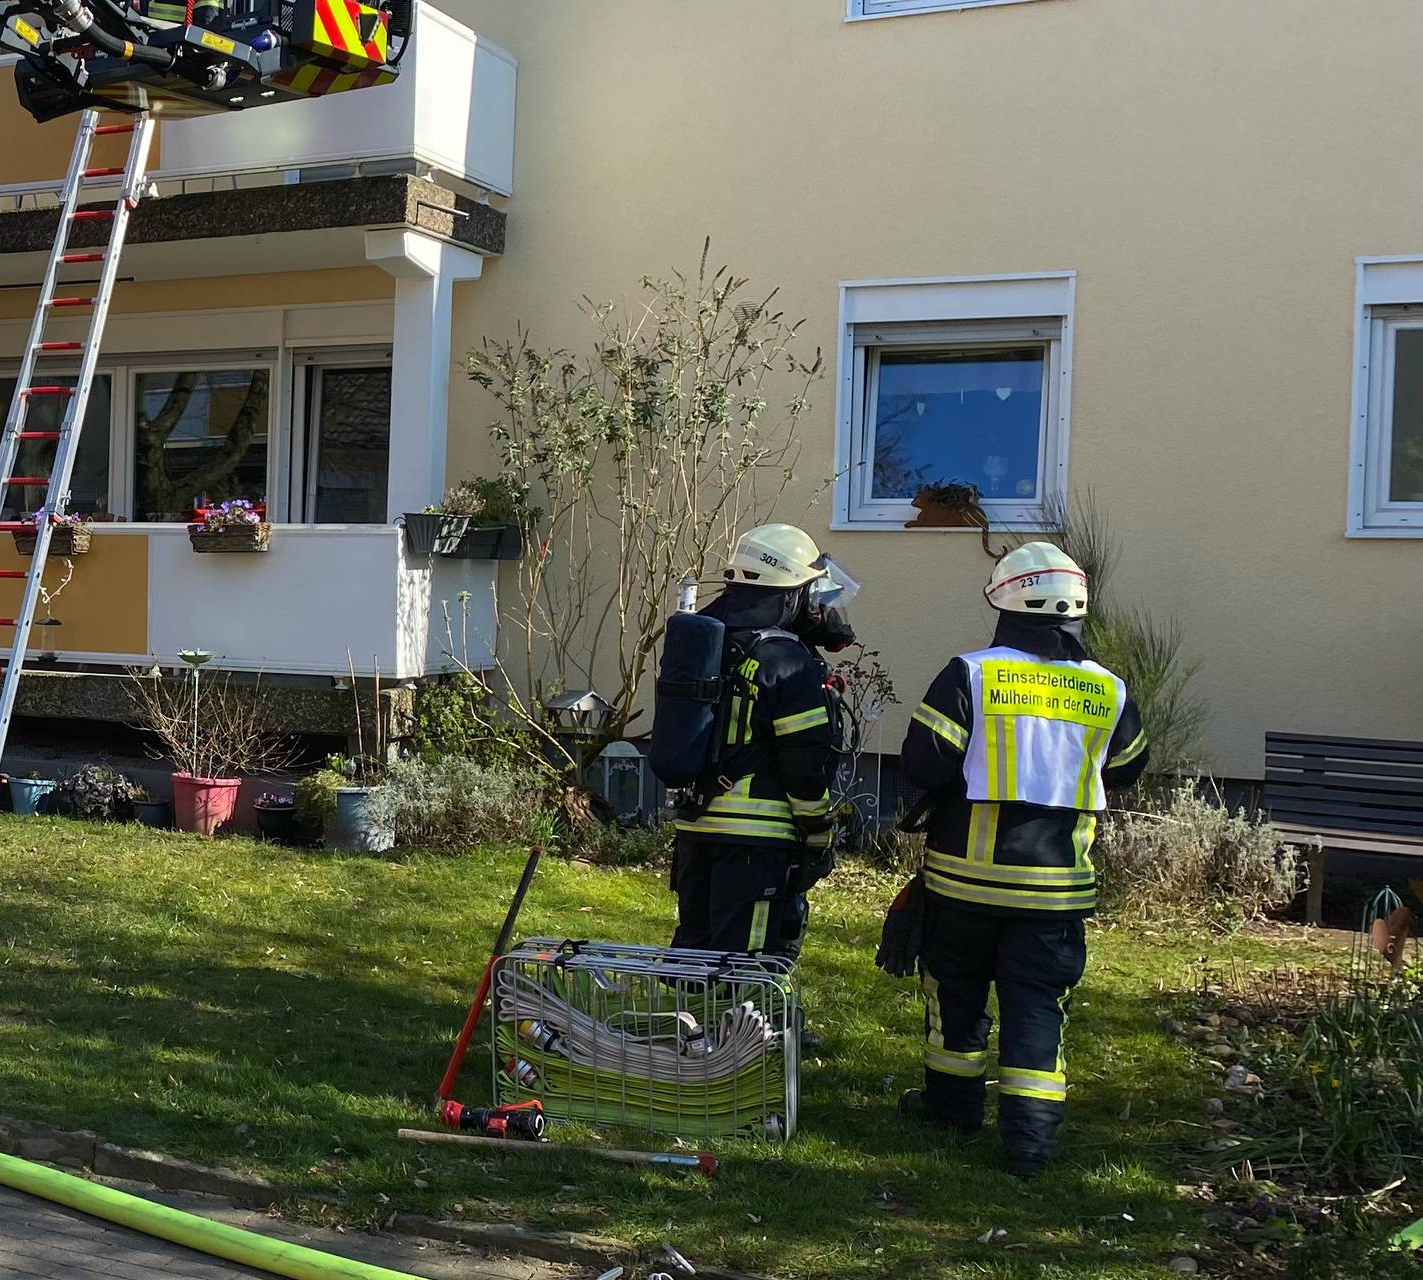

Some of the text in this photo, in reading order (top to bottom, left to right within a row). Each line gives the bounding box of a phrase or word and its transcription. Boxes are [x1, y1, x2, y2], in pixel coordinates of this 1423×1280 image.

[759, 552, 779, 568] 303
[1020, 575, 1041, 589] 237
[996, 668, 1106, 696] Einsatzleitdienst
[989, 688, 1111, 719] Mülheim an der Ruhr
